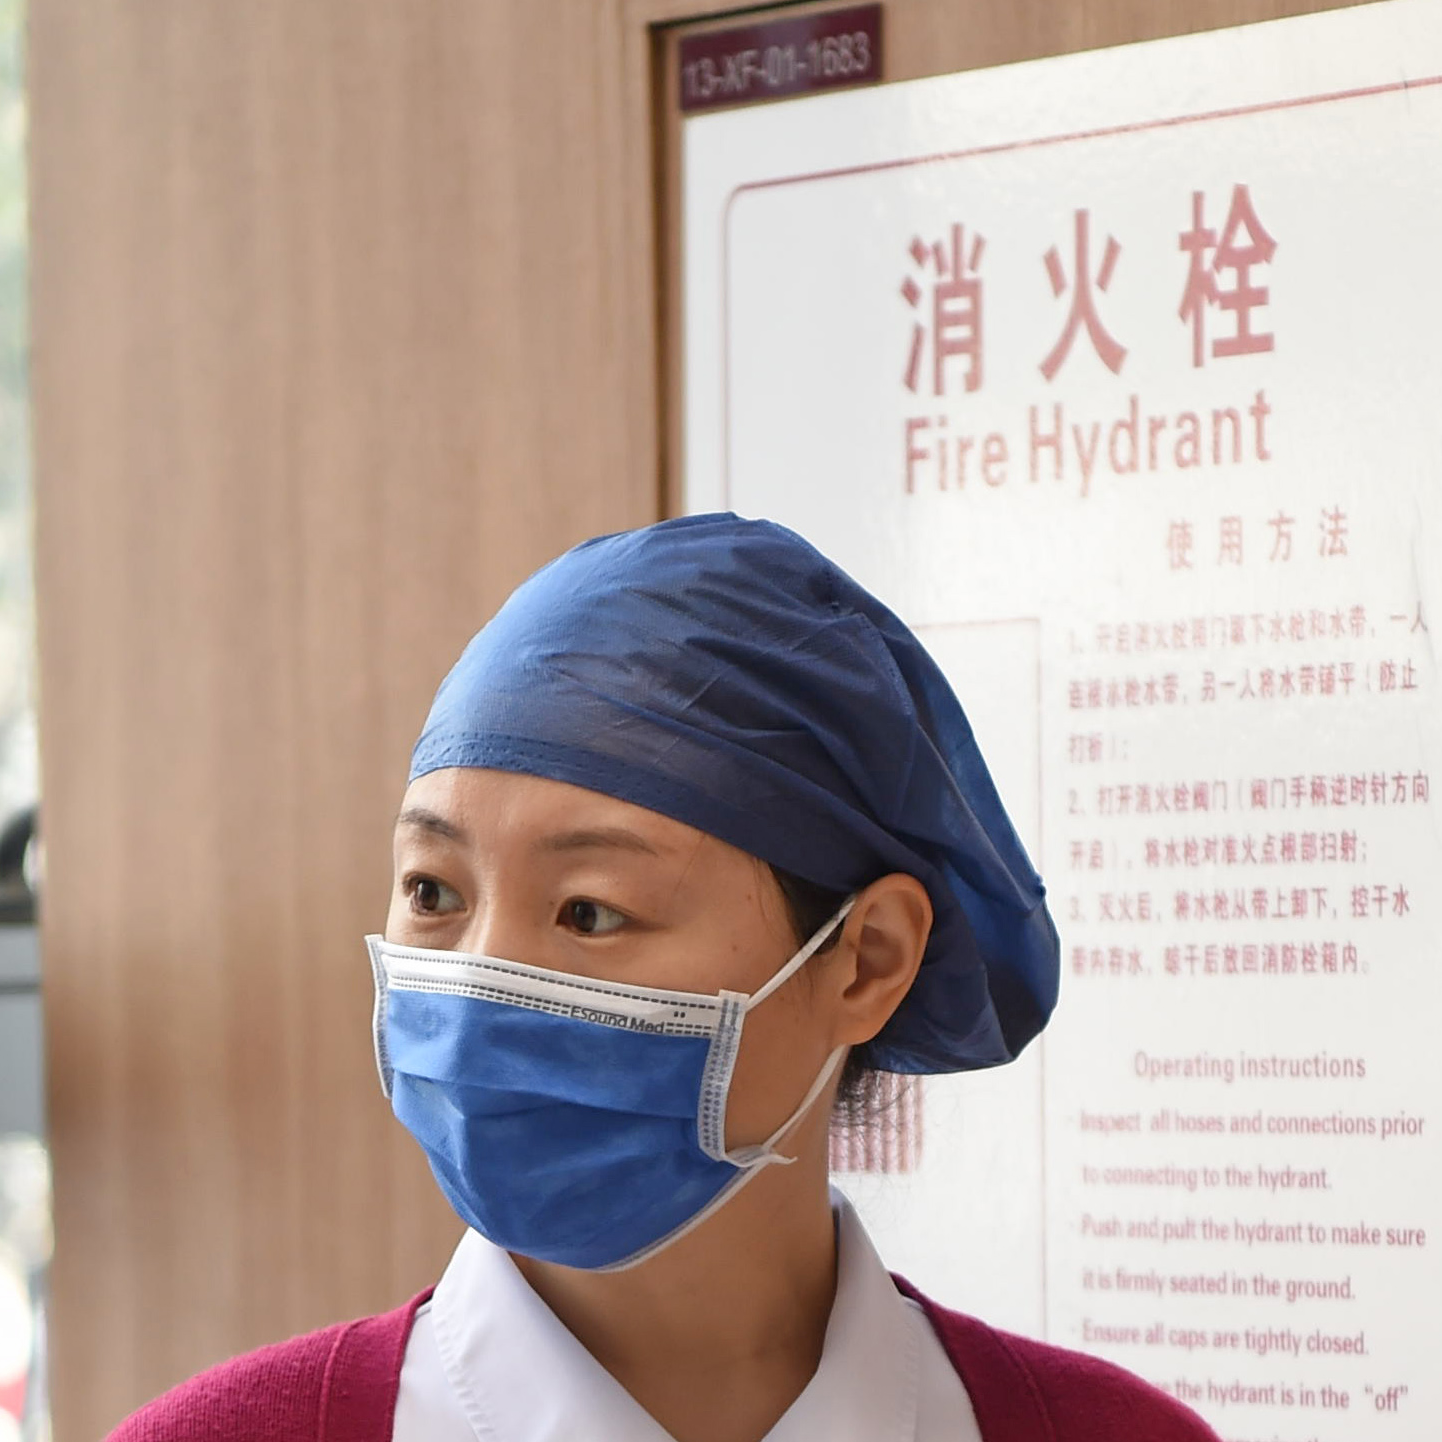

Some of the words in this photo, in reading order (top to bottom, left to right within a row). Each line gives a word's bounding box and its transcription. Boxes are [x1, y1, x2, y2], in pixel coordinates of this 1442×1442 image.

[901, 183, 1277, 397] 消火栓
[903, 416, 1008, 496] Fire
[1028, 389, 1271, 500] Hydrant
[1167, 505, 1349, 572] 使用方法
[631, 1017, 664, 1034] Med
[1134, 1051, 1234, 1082] Operating
[1241, 1051, 1366, 1078] instructions
[1080, 1109, 1141, 1137] Inspect
[1151, 1110, 1170, 1133] all
[1175, 1110, 1225, 1134] hoses
[1230, 1111, 1262, 1134] and
[1267, 1112, 1376, 1137] connections
[1381, 1111, 1425, 1140] prior
[1084, 1165, 1100, 1184] to
[1104, 1164, 1198, 1191] connecting
[1203, 1167, 1220, 1185] to
[1225, 1166, 1253, 1187] the
[1258, 1166, 1332, 1192] hydrant.
[1081, 1214, 1122, 1238] Push
[1127, 1216, 1158, 1239] and
[1202, 1217, 1229, 1240] the
[1234, 1218, 1302, 1246] hydrant
[1308, 1221, 1326, 1243] to
[1332, 1221, 1381, 1246] make
[1386, 1227, 1426, 1247] sure
[1084, 1268, 1094, 1290] it
[1098, 1269, 1112, 1290] is
[1115, 1270, 1164, 1296] firmly
[1170, 1271, 1228, 1295] seated
[1232, 1273, 1248, 1295] in
[1254, 1273, 1281, 1296] the
[1286, 1275, 1356, 1302] ground.
[1082, 1319, 1140, 1344] Ensure
[1145, 1322, 1164, 1346] all
[1169, 1328, 1208, 1351] caps
[1213, 1329, 1240, 1349] are
[1245, 1326, 1302, 1357] tightly
[1307, 1329, 1370, 1355] closed.
[1175, 1380, 1203, 1401] the
[1207, 1381, 1276, 1407] hydrant
[1281, 1382, 1295, 1406] is
[1299, 1383, 1316, 1408] in
[1320, 1385, 1350, 1410] the
